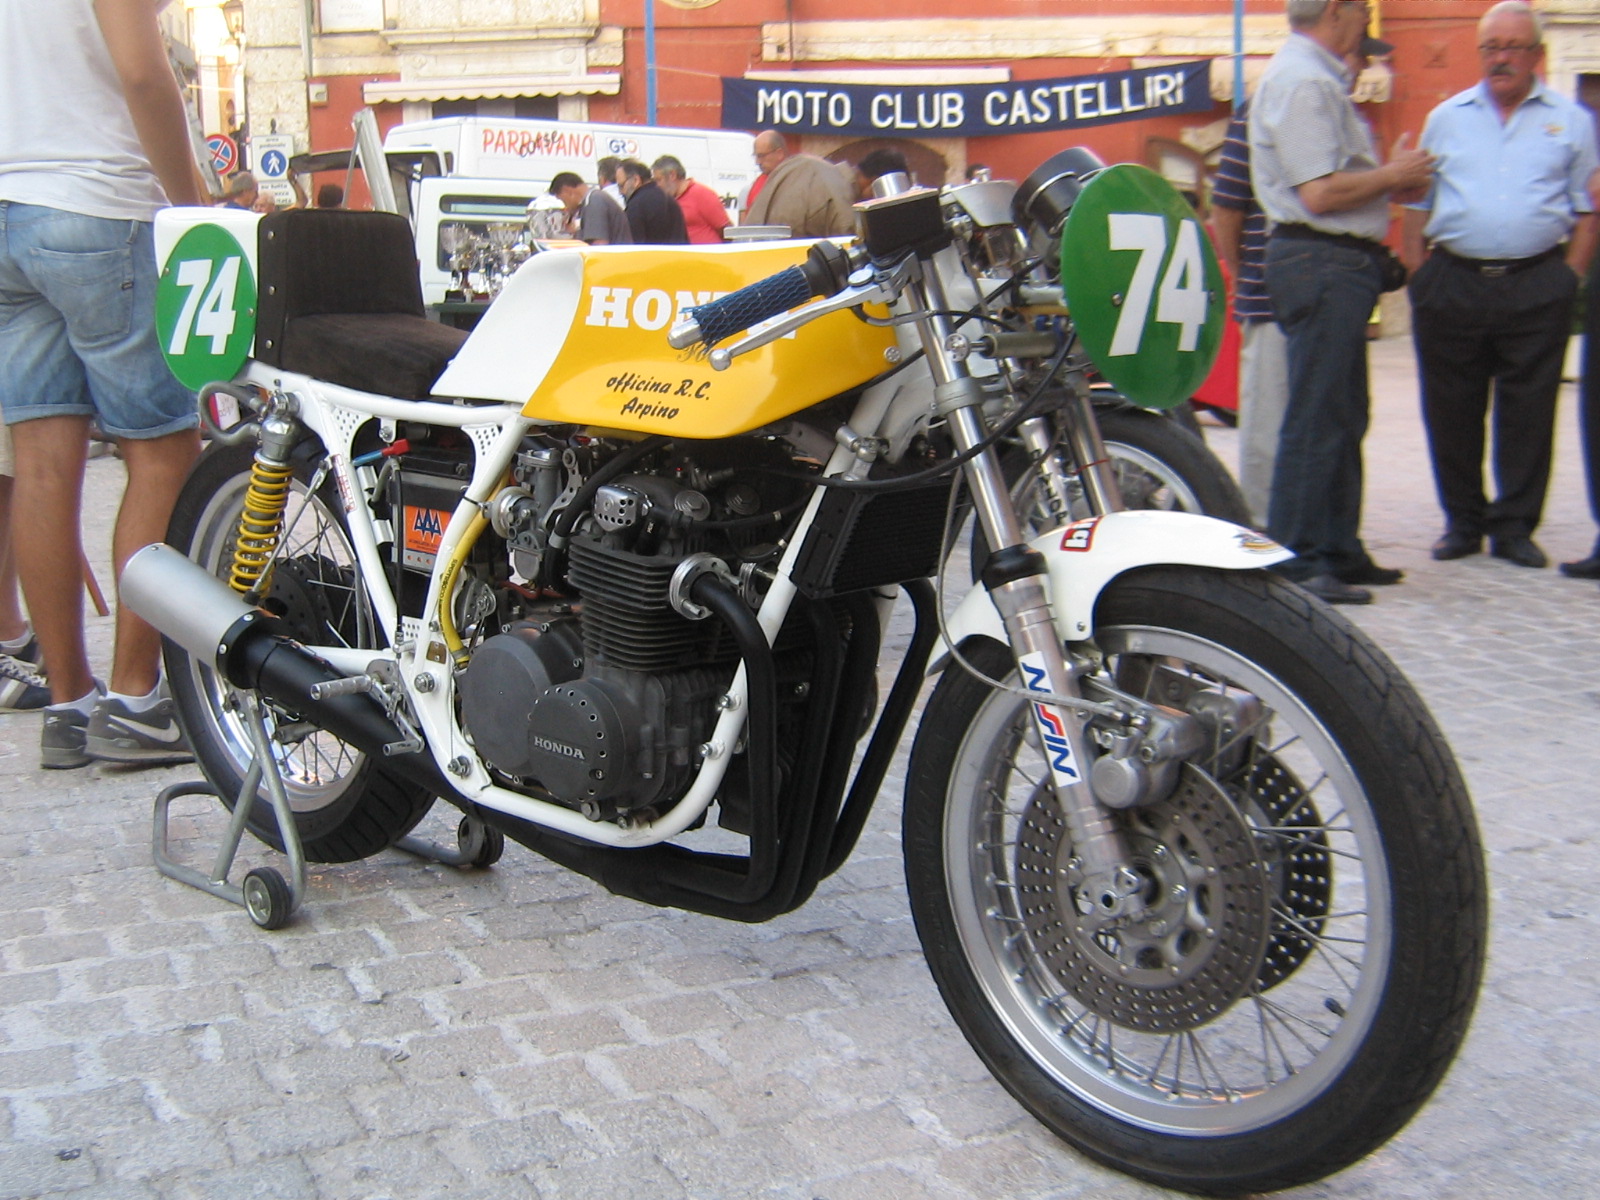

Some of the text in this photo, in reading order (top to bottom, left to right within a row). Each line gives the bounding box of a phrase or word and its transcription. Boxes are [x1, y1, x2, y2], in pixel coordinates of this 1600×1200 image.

[756, 70, 1185, 130] MOTO CLUB CASTELLIRI
[168, 256, 242, 355] 74
[1108, 213, 1208, 357] 74
[606, 372, 671, 395] officina
[620, 396, 679, 420] Arpino
[534, 736, 585, 760] HONDA
